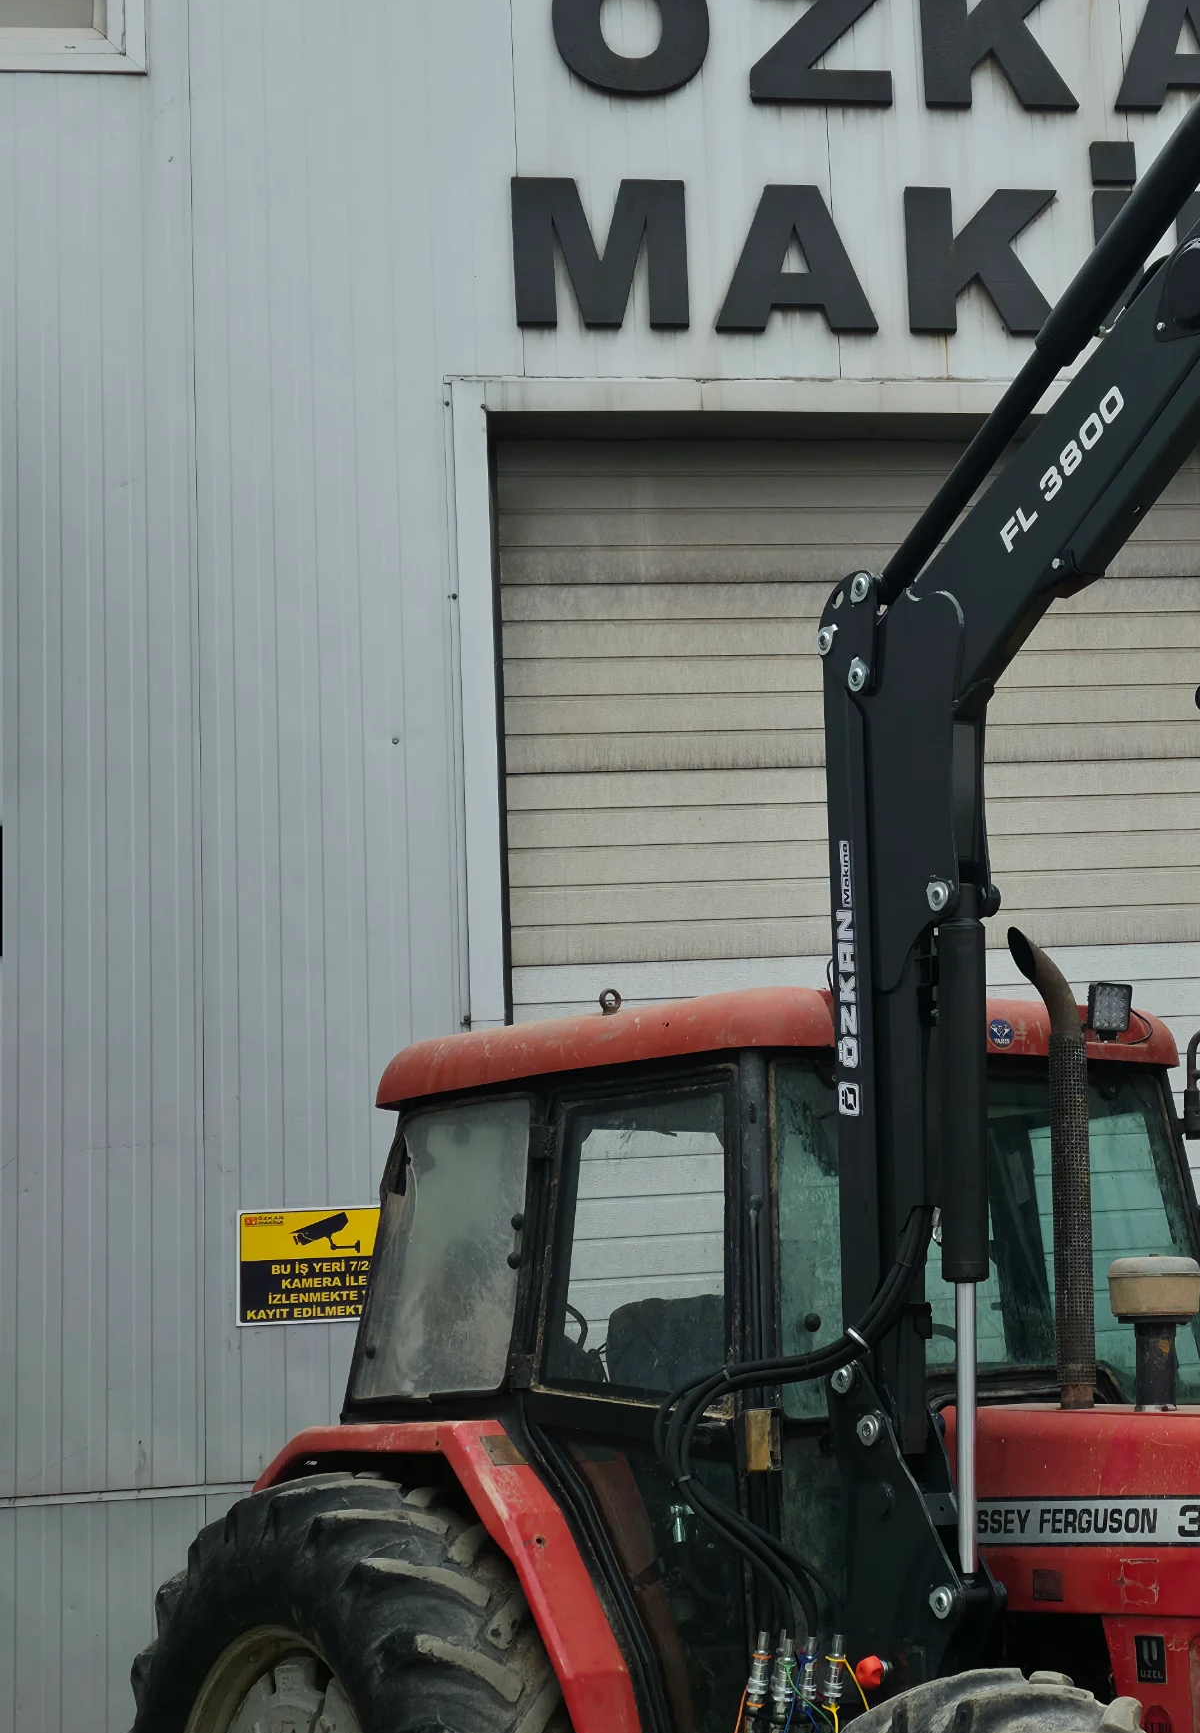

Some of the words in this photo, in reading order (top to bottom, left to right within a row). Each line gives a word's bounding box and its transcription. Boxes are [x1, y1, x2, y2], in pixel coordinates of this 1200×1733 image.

[1000, 507, 1038, 553] FL
[1040, 386, 1124, 501] 3800
[836, 910, 858, 1069] ÖZKAN
[271, 1264, 291, 1275] BU
[295, 1261, 309, 1276] İŞ
[313, 1259, 345, 1273] YERİ
[349, 1260, 371, 1272] 7/2
[281, 1276, 341, 1289] KAMERA
[345, 1274, 367, 1286] İLE
[268, 1290, 358, 1305] İZLENMEKTE
[246, 1308, 289, 1320] KAYIT
[293, 1304, 363, 1318] EDİLMEKT
[977, 1509, 1031, 1534] SSEY
[1039, 1507, 1158, 1534] FERGUSON
